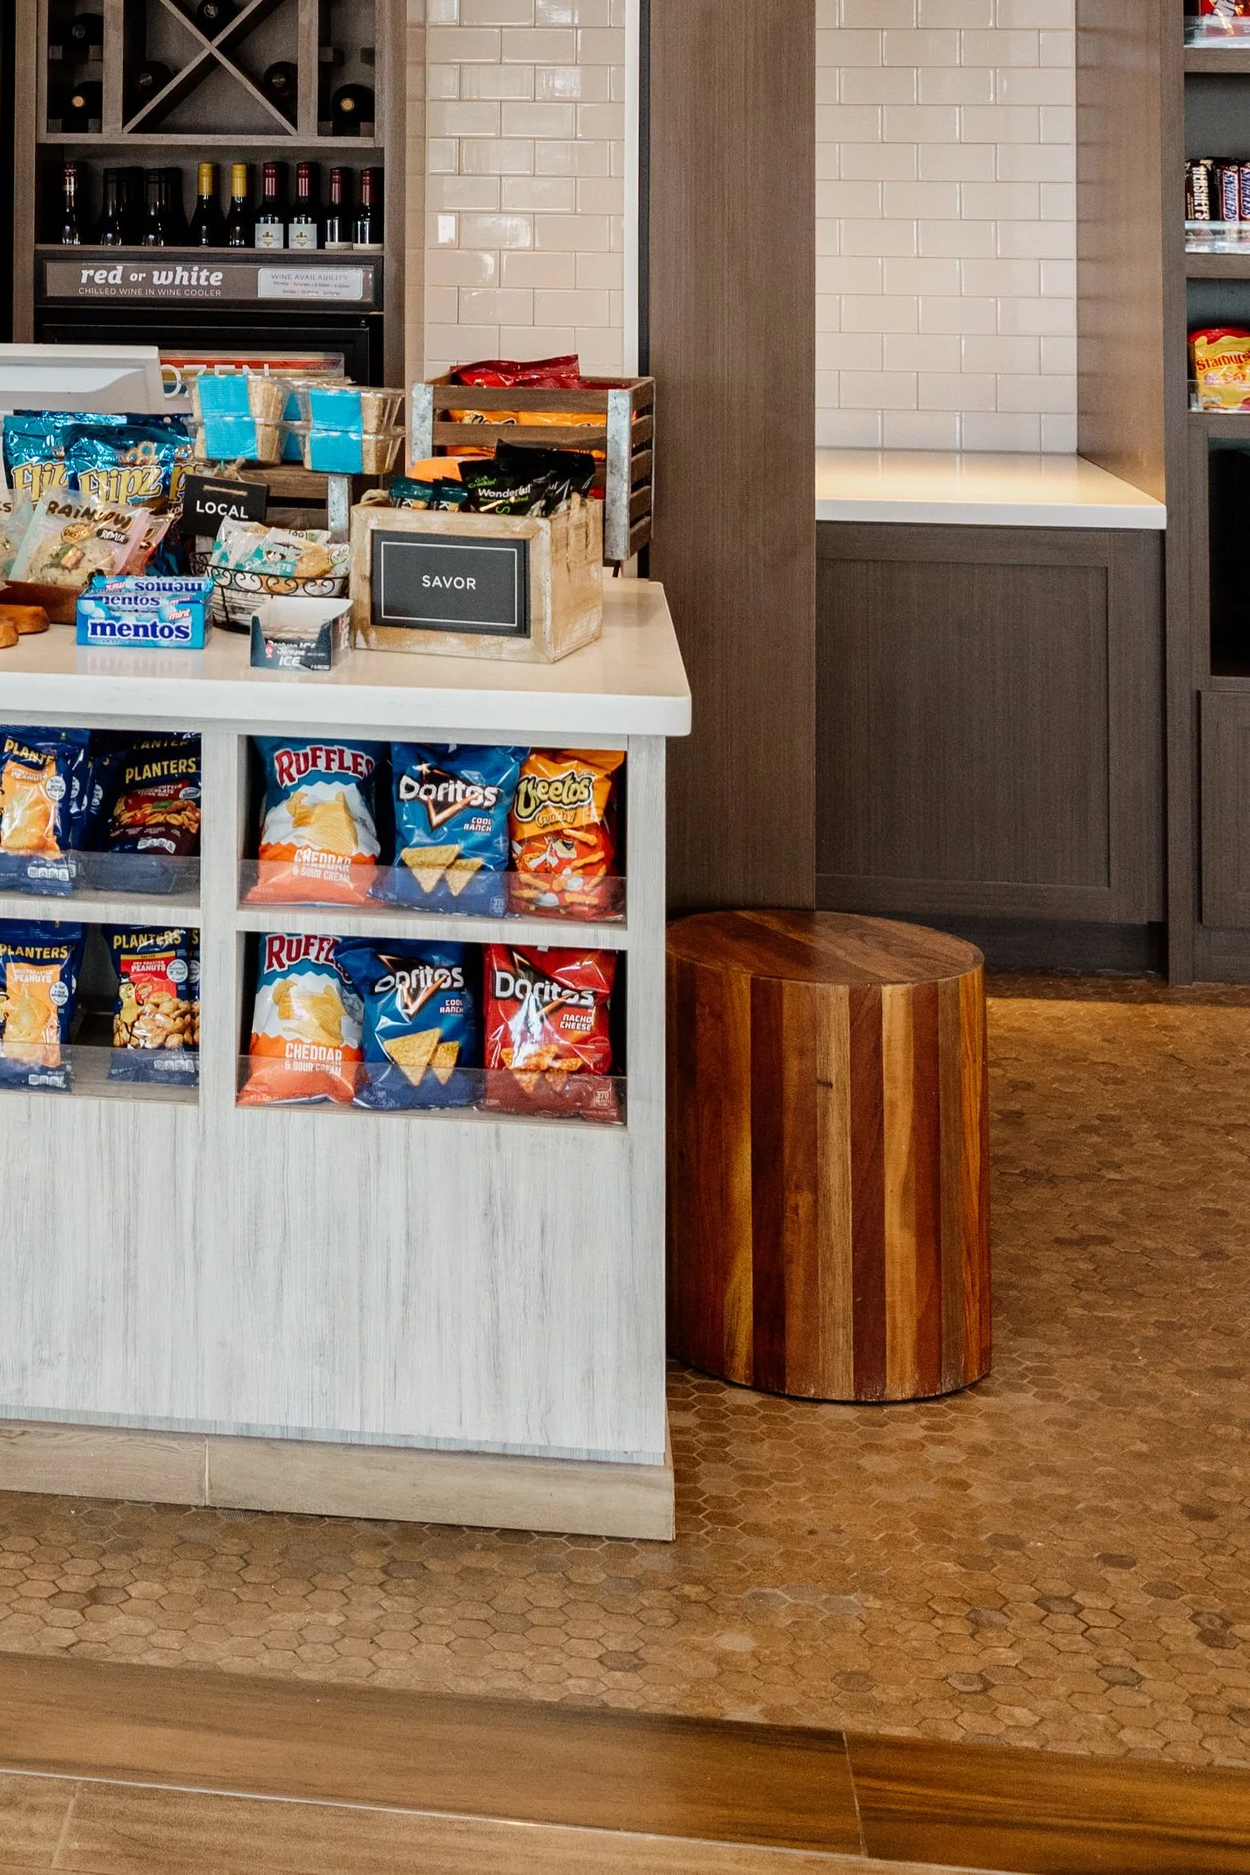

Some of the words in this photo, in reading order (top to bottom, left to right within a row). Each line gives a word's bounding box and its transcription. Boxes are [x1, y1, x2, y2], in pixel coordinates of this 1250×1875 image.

[80, 265, 124, 285] red
[130, 272, 146, 282] or
[152, 266, 223, 286] white
[78, 287, 117, 295] CHILLED
[157, 288, 181, 296] WINE
[184, 289, 221, 297] COOLER
[79, 466, 162, 506] Flipz
[478, 484, 531, 498] Wonderful
[196, 500, 249, 519] LOCAL
[134, 581, 203, 592] mentos
[421, 574, 477, 591] SAVOR
[168, 608, 190, 621] mint
[89, 621, 190, 640] mentos
[279, 656, 301, 666] ICE
[4, 738, 55, 766] PLANTE
[125, 756, 197, 784] PLANTERS
[274, 745, 376, 787] RUFFLES
[399, 774, 499, 808] Doritos
[515, 772, 592, 820] Cheetos
[471, 817, 492, 825] COOL
[535, 810, 577, 827] Crunchy
[463, 824, 492, 833] RANCH
[294, 849, 352, 870] CHEDDAR
[113, 929, 182, 950] PLANTERS
[131, 964, 166, 972] PEANUTS
[14, 974, 52, 983] PEANUTS
[374, 966, 464, 993] Doritos
[494, 971, 594, 1007] Doritos
[439, 1006, 464, 1014] RANCH
[445, 999, 463, 1007] COOL
[559, 1022, 592, 1031] CHEESE
[563, 1014, 593, 1023] NACHO
[285, 1042, 342, 1062] CHEDDAR
[284, 1061, 290, 1069] &
[292, 1062, 313, 1072] SOUR
[315, 1063, 342, 1076] CREAM
[595, 1090, 609, 1099] 370
